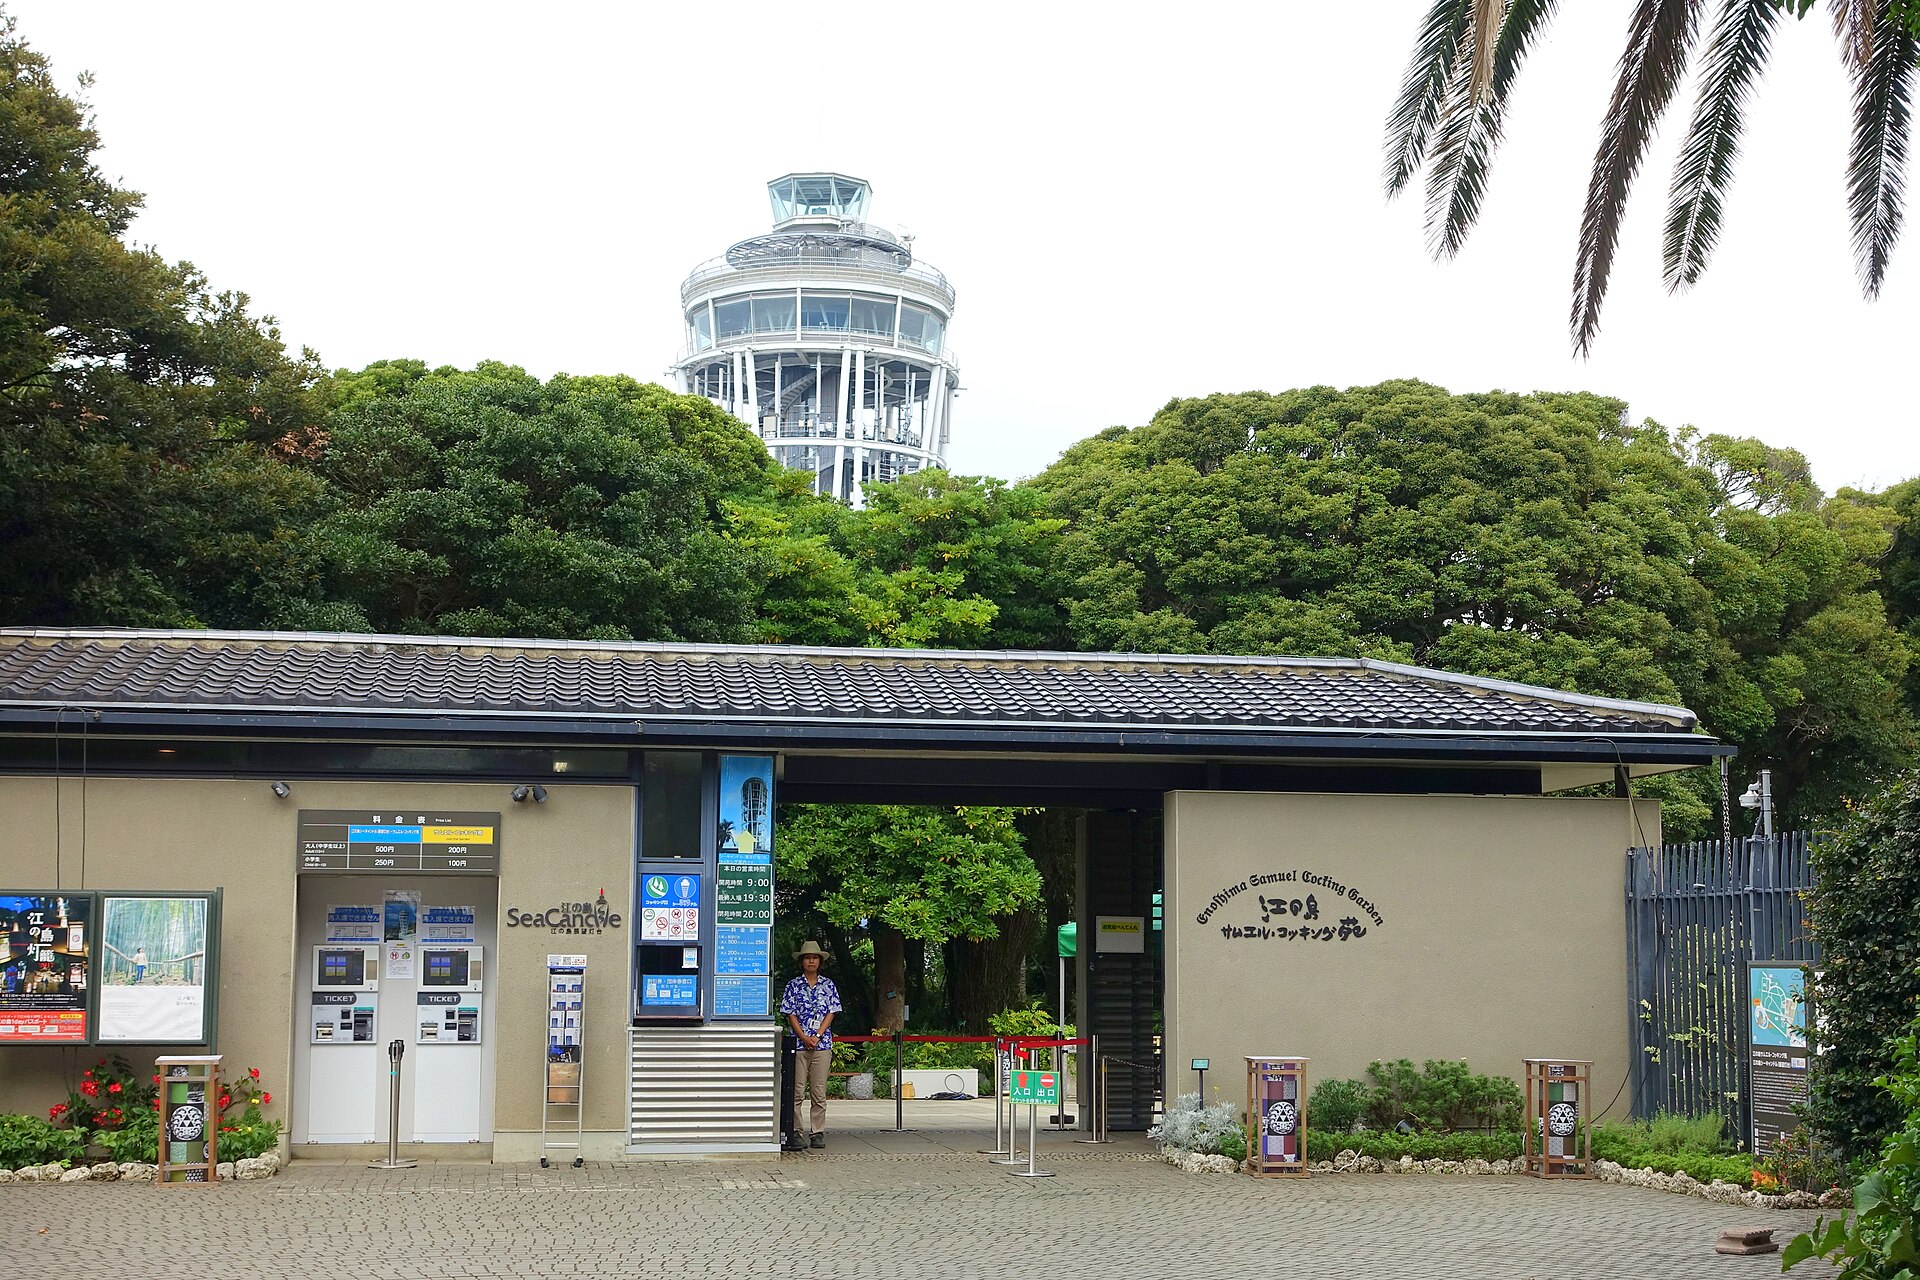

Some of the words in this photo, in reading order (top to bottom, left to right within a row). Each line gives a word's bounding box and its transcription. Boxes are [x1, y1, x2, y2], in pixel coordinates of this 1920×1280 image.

[373, 815, 426, 824] 料金表
[375, 845, 395, 853] 500円
[448, 846, 467, 854] 200円
[374, 858, 394, 866] 250円
[448, 859, 467, 867] 100円
[723, 865, 766, 873] 本日の営業時間
[747, 878, 769, 887] 9:00
[743, 893, 770, 903] 19:30
[1249, 869, 1297, 887] Samuel
[1301, 870, 1346, 896] Cocking
[1347, 888, 1384, 927] Garden
[561, 902, 592, 914] 江の島
[507, 903, 622, 928] SeaCandle
[743, 910, 770, 918] 20:00
[1013, 1087, 1031, 1096] 入口
[1037, 1088, 1055, 1097] 出口
